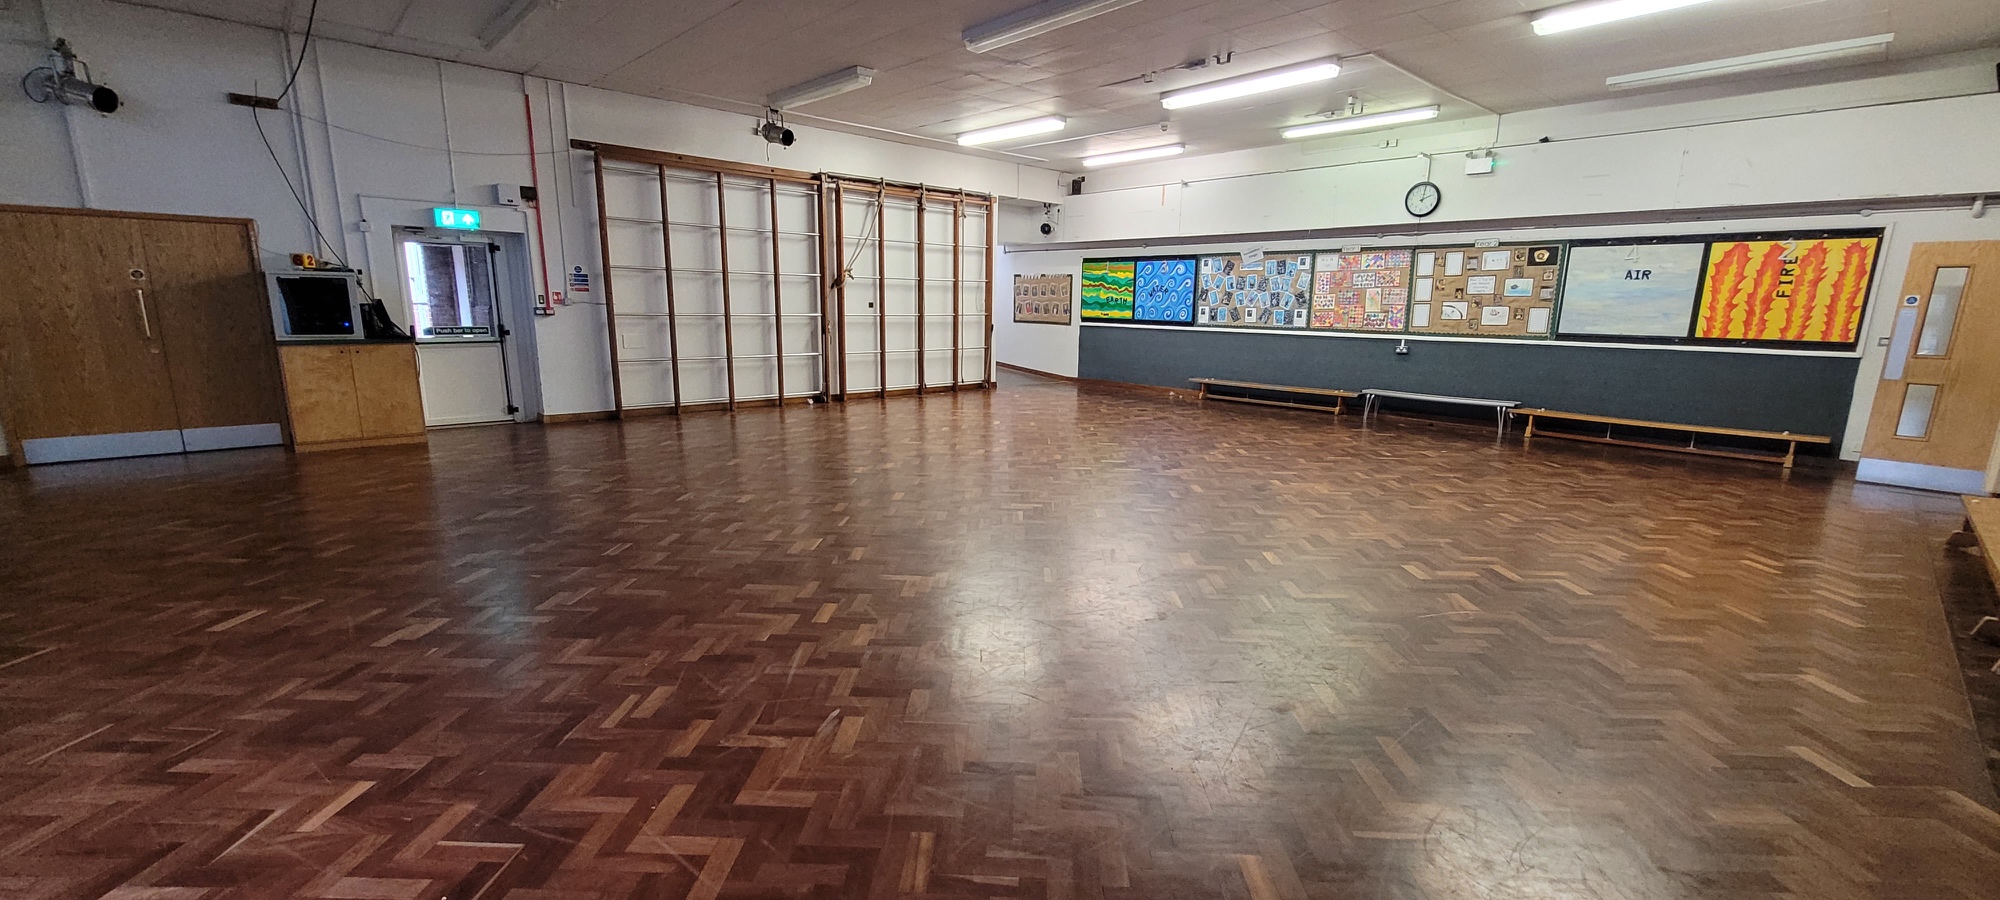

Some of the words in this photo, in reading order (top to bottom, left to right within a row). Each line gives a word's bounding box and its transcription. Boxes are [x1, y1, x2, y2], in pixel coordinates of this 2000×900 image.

[1624, 243, 1640, 263] 4
[1777, 237, 1797, 260] 2
[307, 255, 315, 266] 2
[1624, 269, 1652, 280] AIR
[1775, 256, 1799, 298] FIRE
[1148, 284, 1169, 298] WATER
[1105, 296, 1128, 304] EARTH
